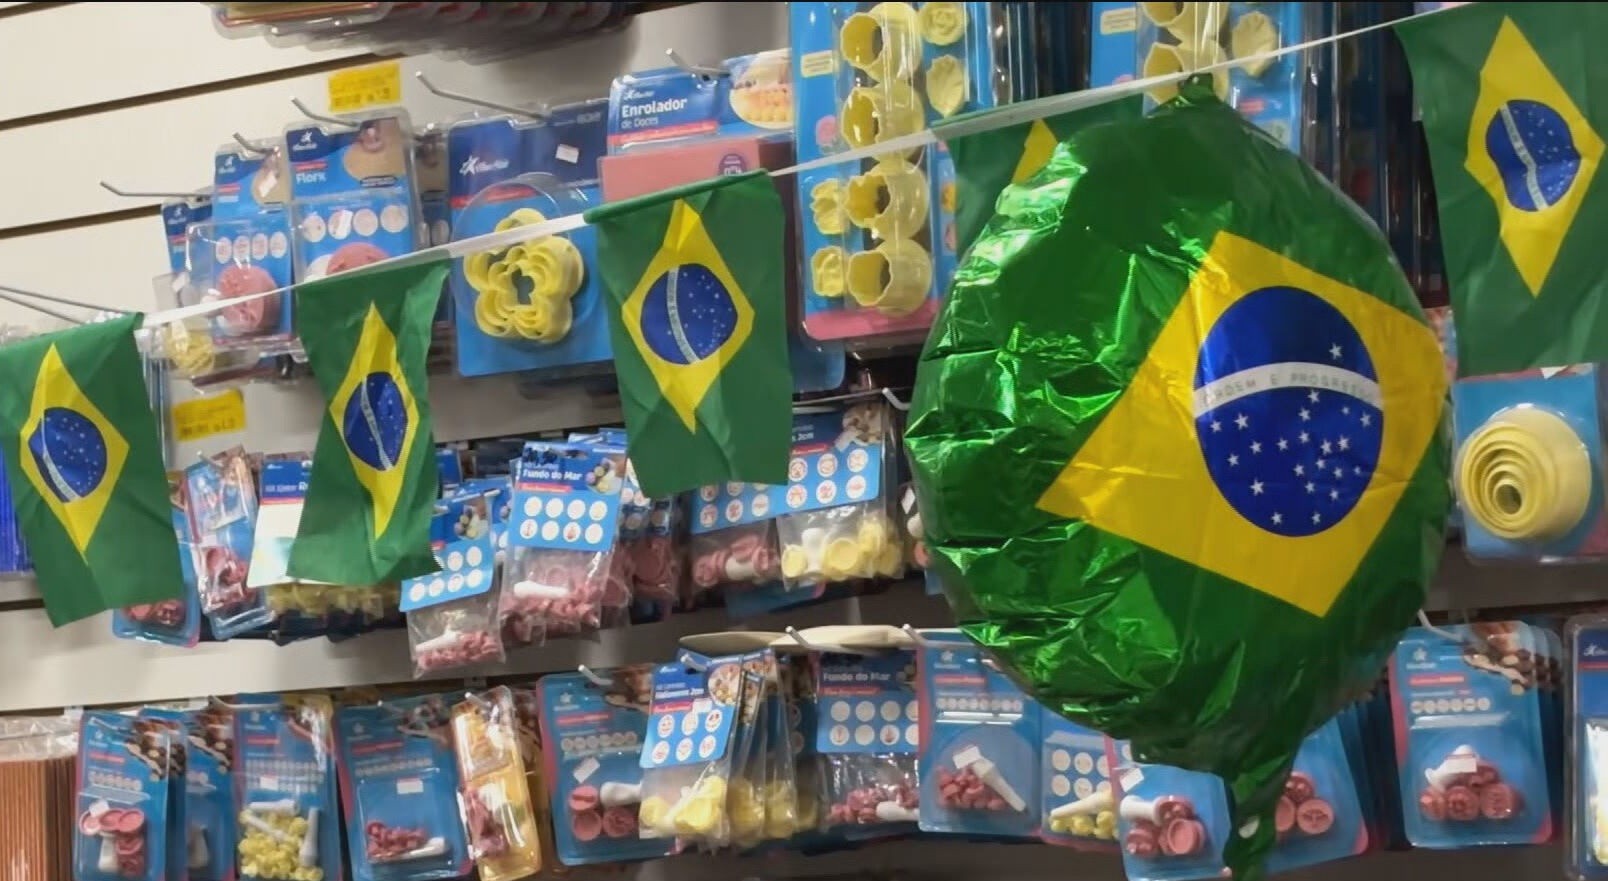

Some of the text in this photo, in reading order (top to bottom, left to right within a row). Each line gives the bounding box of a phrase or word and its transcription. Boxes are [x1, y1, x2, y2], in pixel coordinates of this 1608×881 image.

[622, 98, 687, 117] Enrolador
[621, 117, 659, 129] de Doces
